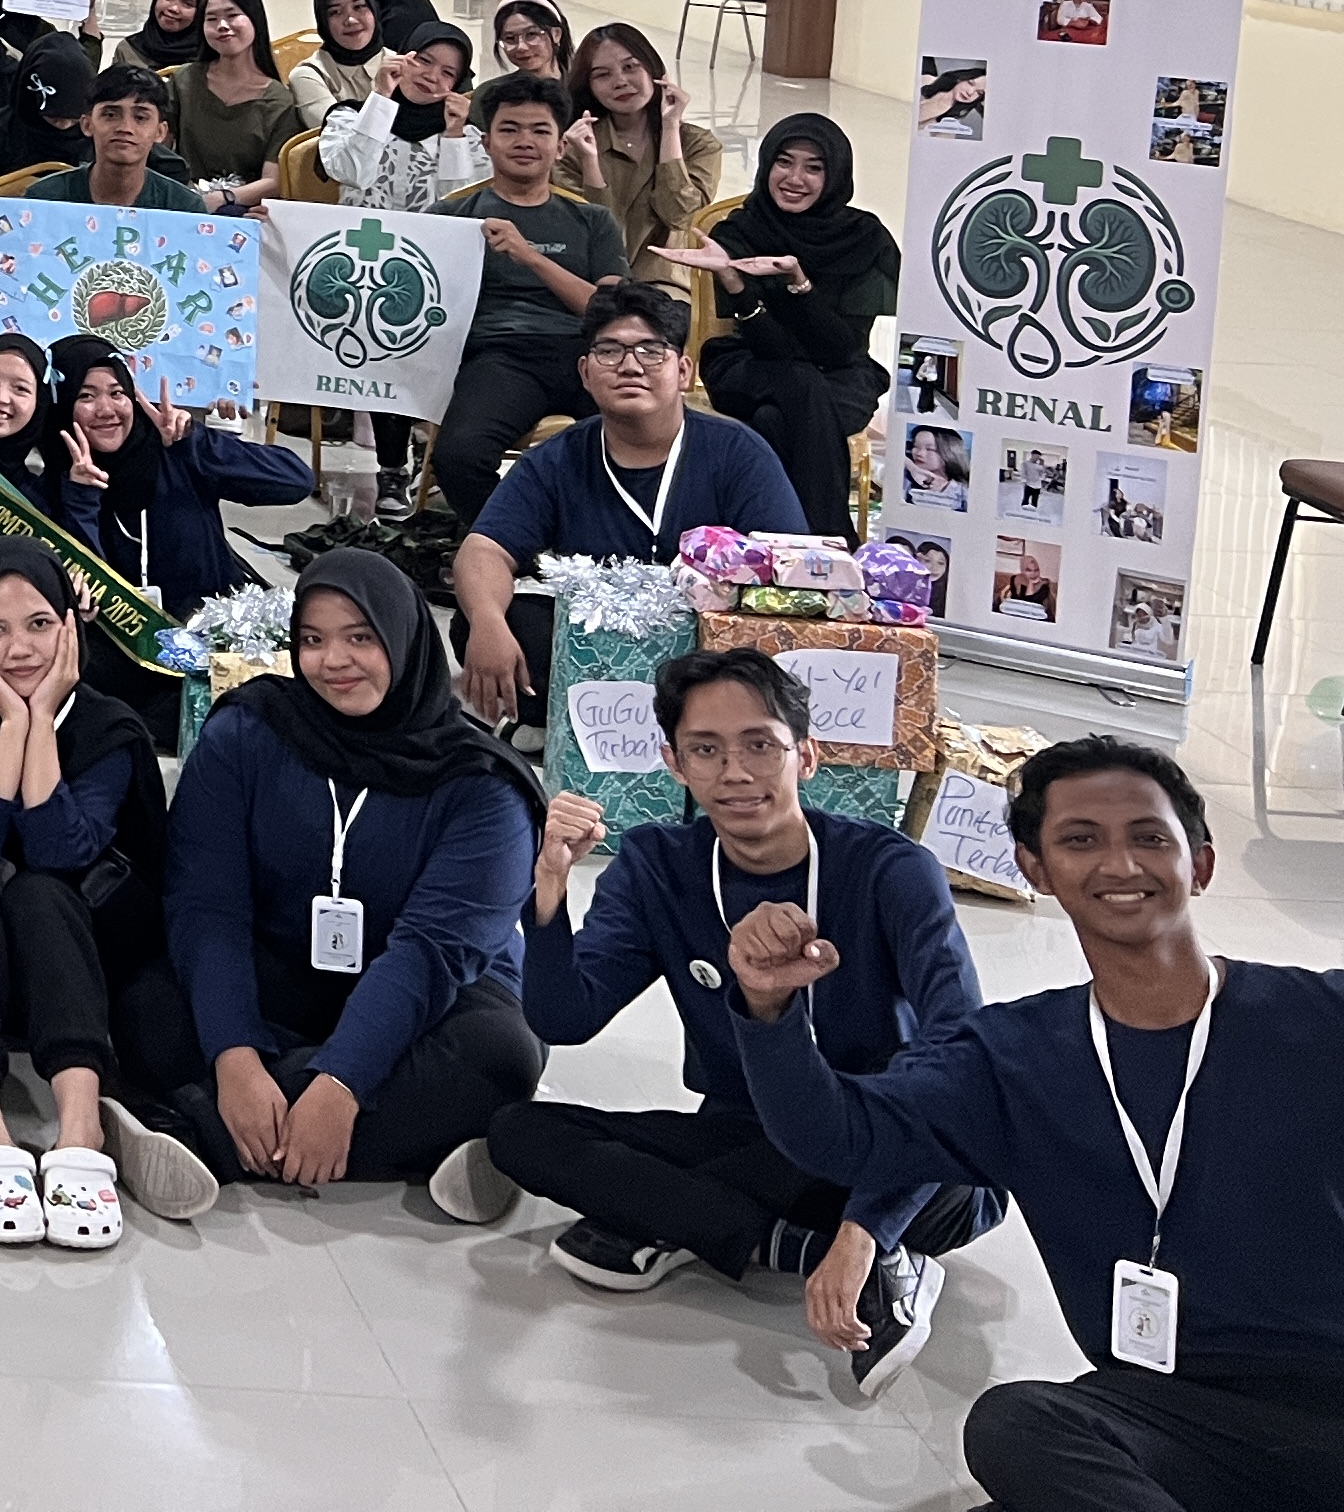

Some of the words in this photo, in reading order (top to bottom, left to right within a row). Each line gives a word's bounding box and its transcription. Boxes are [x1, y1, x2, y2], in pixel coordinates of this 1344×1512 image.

[27, 226, 214, 327] HEPAR
[316, 374, 397, 399] RENAL
[975, 387, 1112, 433] RENAL
[102, 595, 149, 637] 2025
